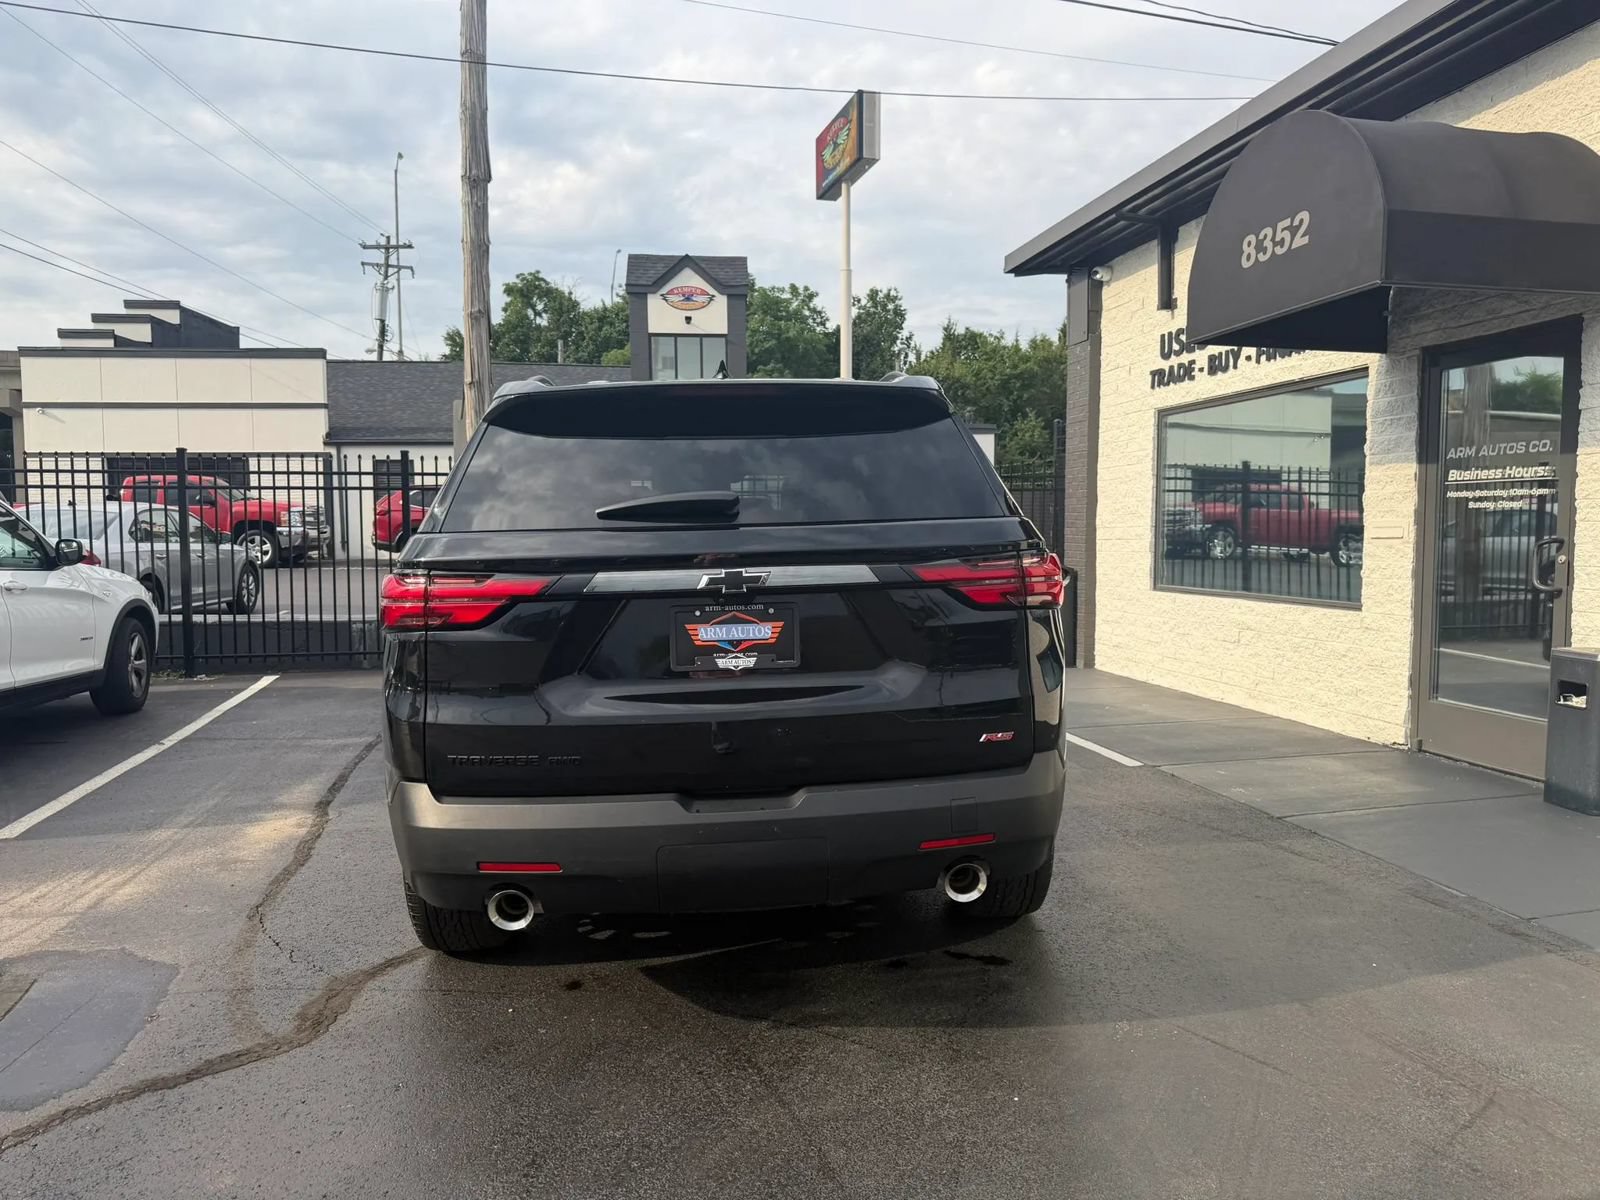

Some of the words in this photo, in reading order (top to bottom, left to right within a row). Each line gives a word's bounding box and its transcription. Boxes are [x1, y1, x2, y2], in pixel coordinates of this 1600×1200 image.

[1240, 208, 1311, 269] 8352
[1160, 328, 1209, 361] US
[1150, 359, 1196, 390] TRADE
[1207, 346, 1242, 376] BUY
[1446, 446, 1477, 460] ARM
[1478, 442, 1527, 457] AUTOS
[1528, 439, 1553, 453] CO.
[1447, 467, 1504, 481] Business
[1497, 499, 1523, 508] Closed
[705, 604, 764, 612] arm-autos.com
[699, 627, 727, 639] ARM
[729, 625, 772, 638] AUTOS
